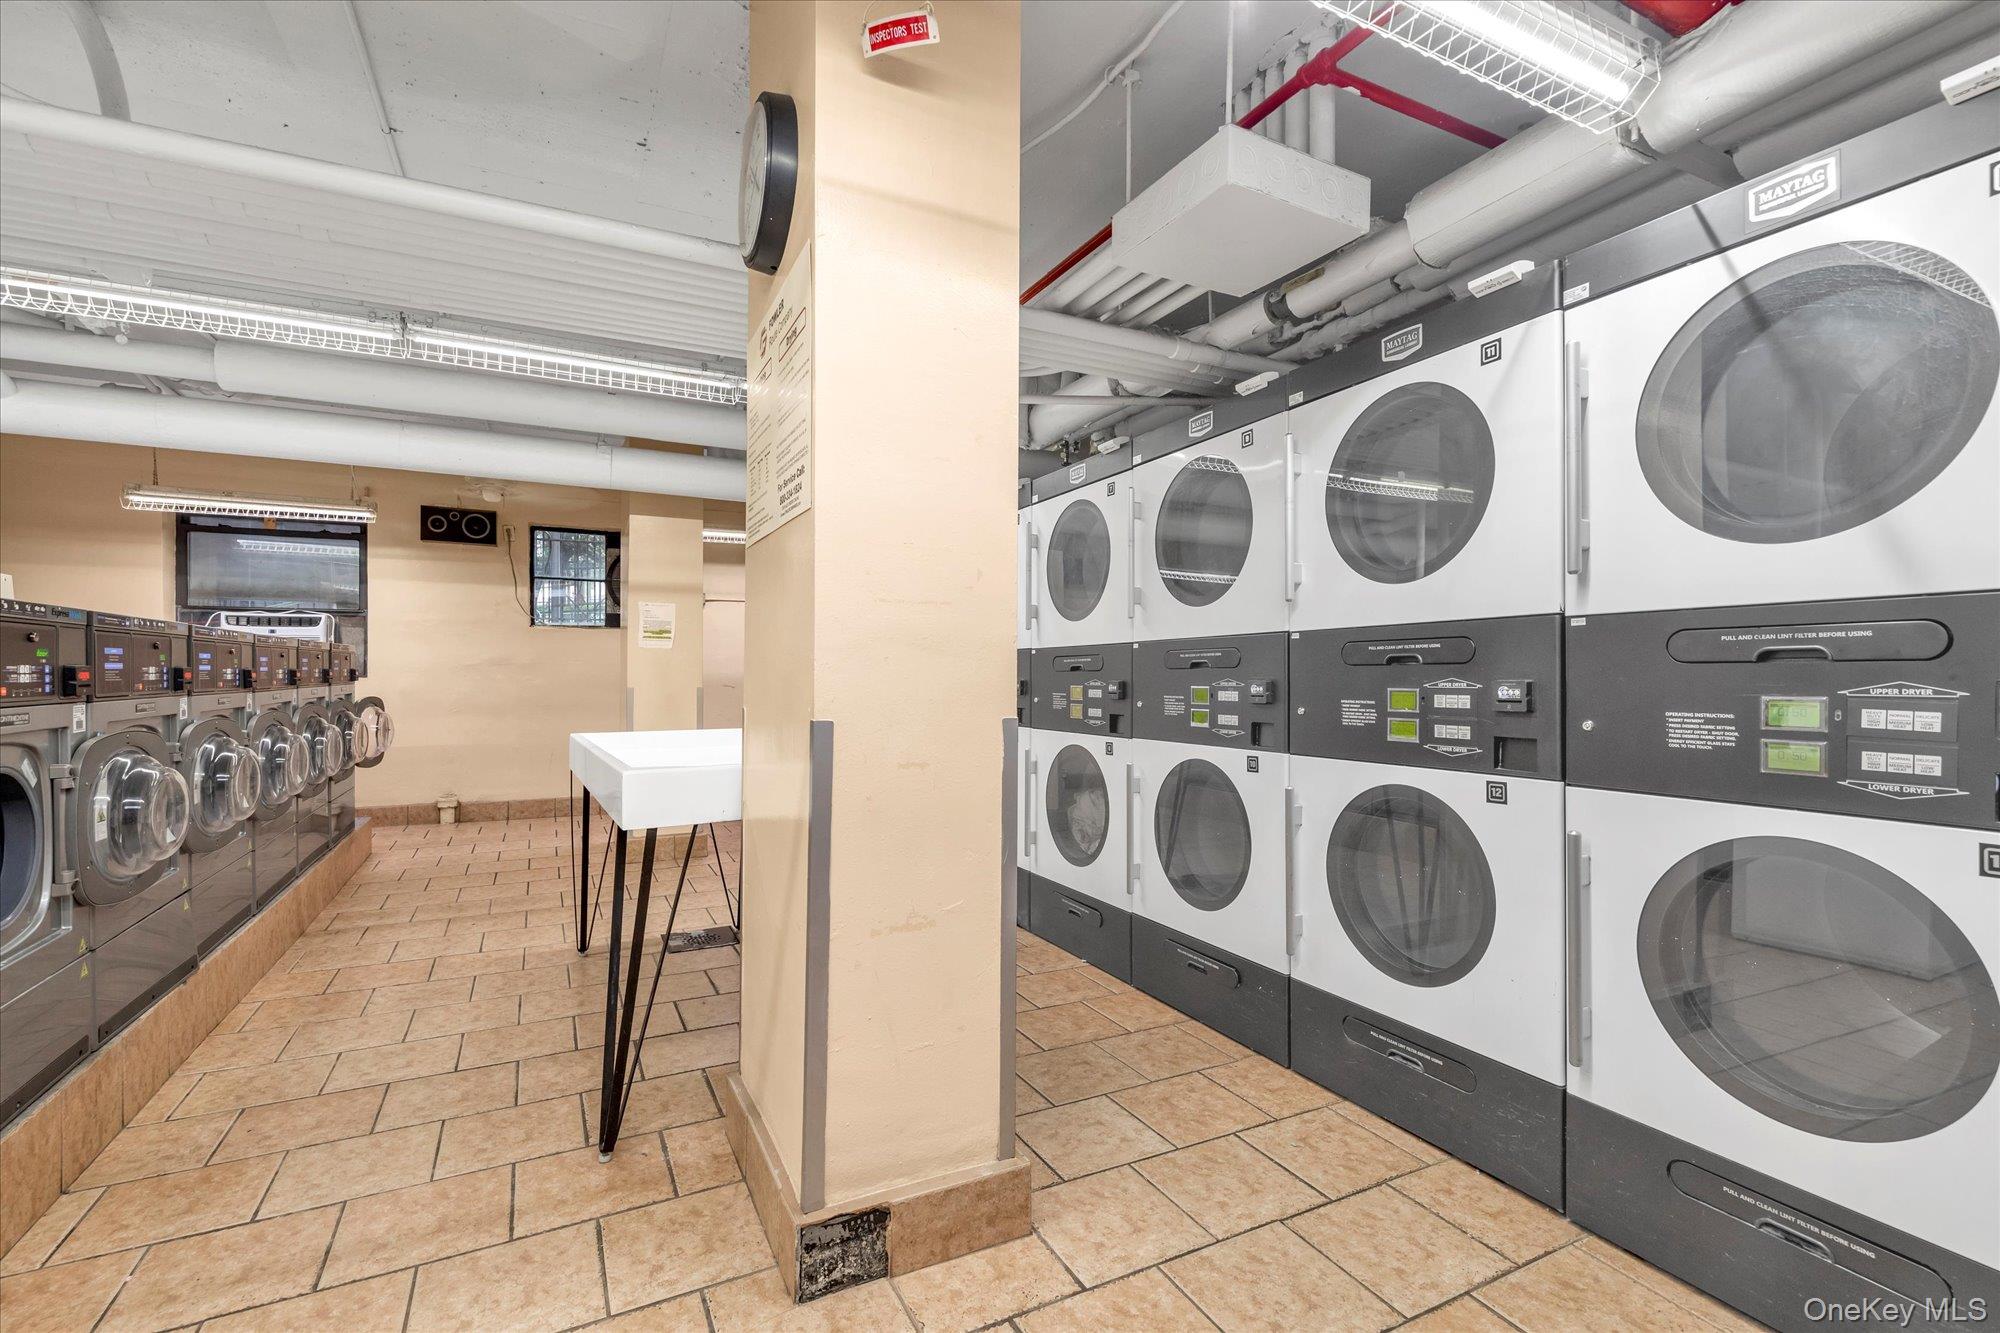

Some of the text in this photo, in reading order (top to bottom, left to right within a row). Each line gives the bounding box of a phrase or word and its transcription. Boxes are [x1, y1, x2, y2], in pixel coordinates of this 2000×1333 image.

[869, 22, 927, 45] INSPECTORS TEST
[1758, 169, 1825, 205] MAYTAG
[769, 298, 784, 331] FOWLER
[1385, 331, 1418, 351] MAYTAG
[783, 473, 796, 489] Service
[1491, 787, 1502, 798] 12
[1868, 784, 1934, 795] LOWER DRYER
[1723, 1186, 1876, 1259] PULL AND CLEAN LINT FILTER BEFORE USING
